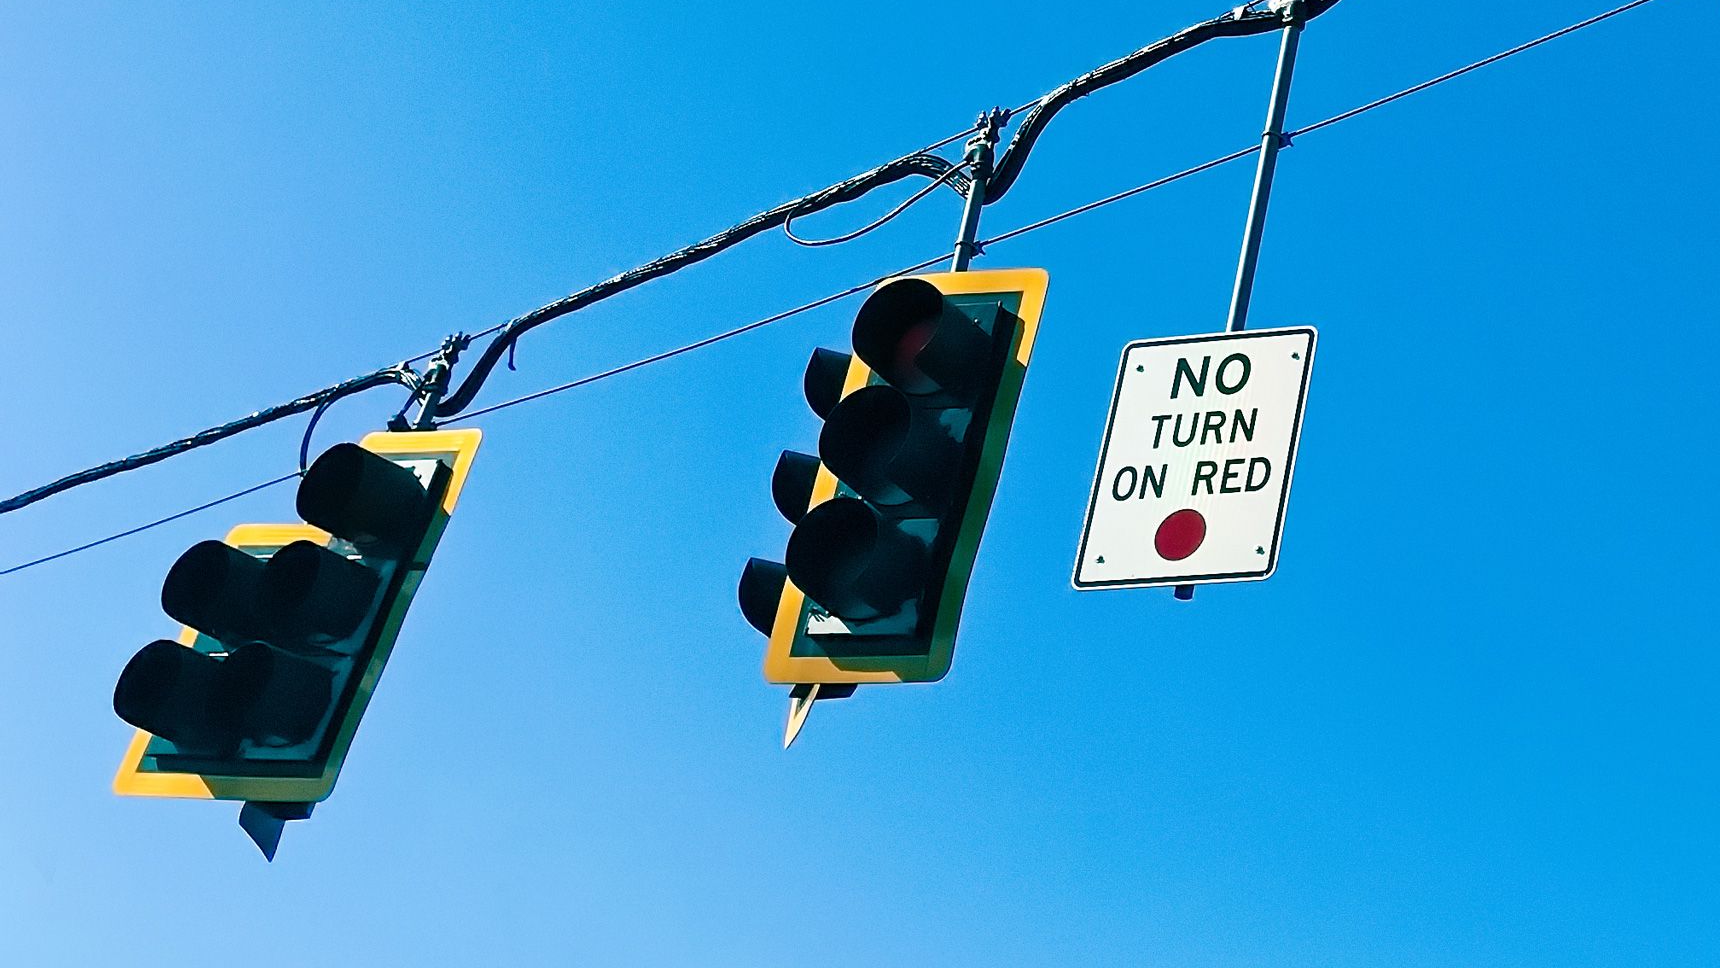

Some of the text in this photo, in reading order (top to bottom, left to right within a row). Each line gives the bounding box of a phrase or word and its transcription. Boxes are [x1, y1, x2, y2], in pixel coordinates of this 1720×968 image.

[1170, 353, 1252, 399] NO
[1151, 408, 1258, 449] TURN
[1112, 457, 1272, 502] ON RED
